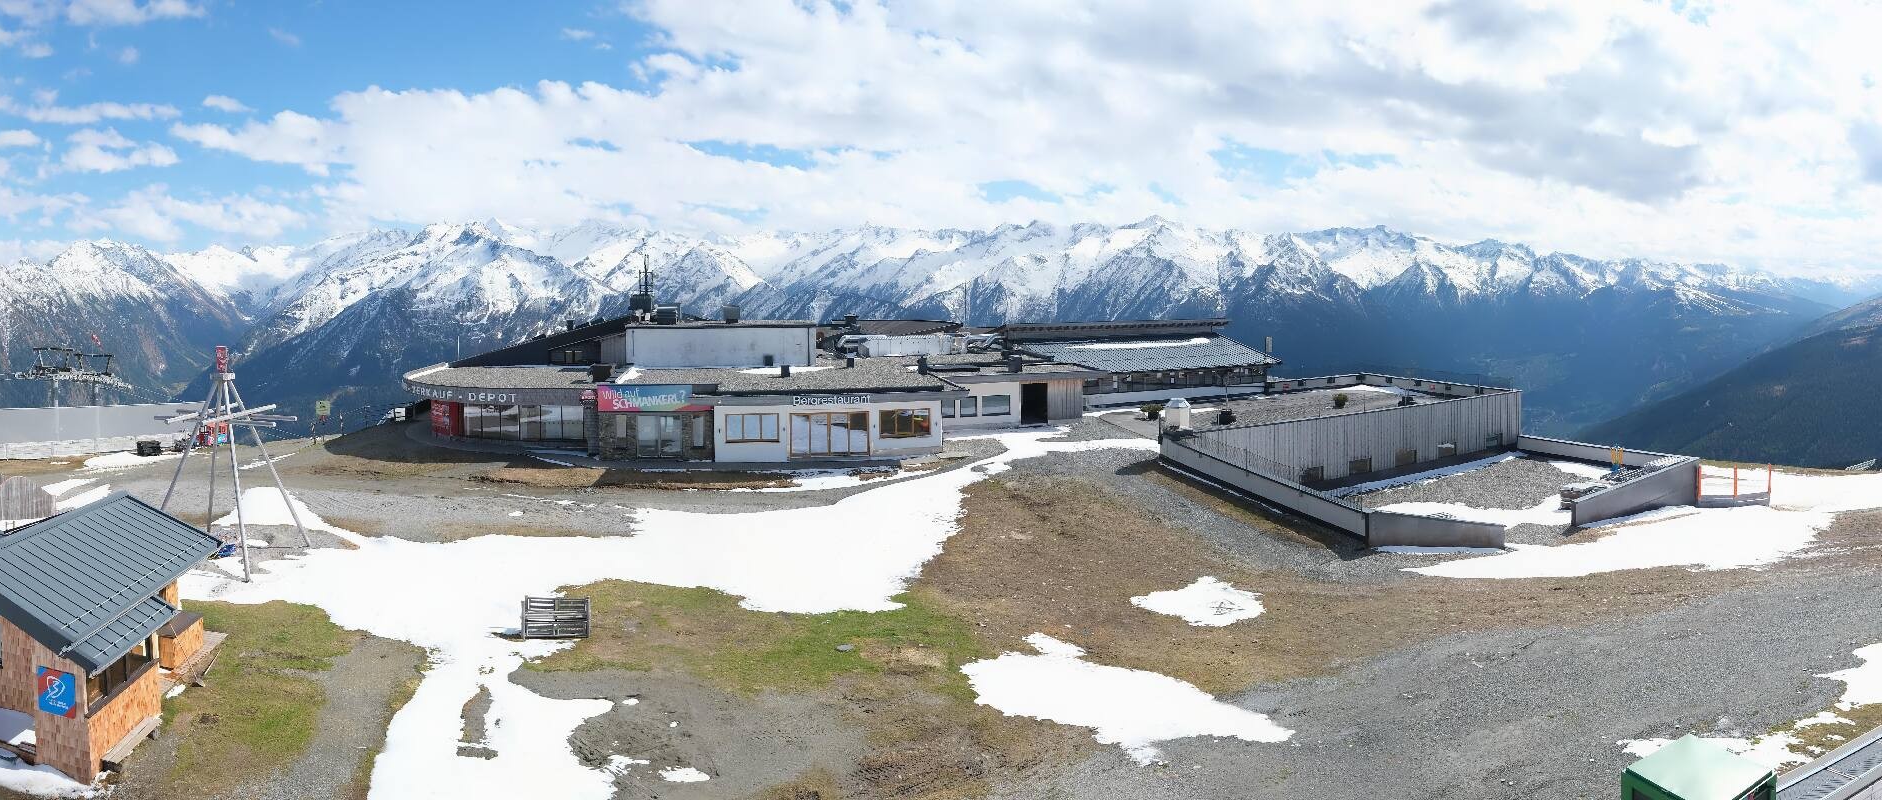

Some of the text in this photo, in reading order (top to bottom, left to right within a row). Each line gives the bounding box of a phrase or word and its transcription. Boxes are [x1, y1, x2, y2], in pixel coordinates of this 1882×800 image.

[468, 393, 517, 403] DEPOT
[602, 389, 623, 400] Wild
[625, 388, 640, 398] auf
[613, 390, 686, 410] SCHMANKERL?
[793, 394, 871, 406] Bergrestaurant
